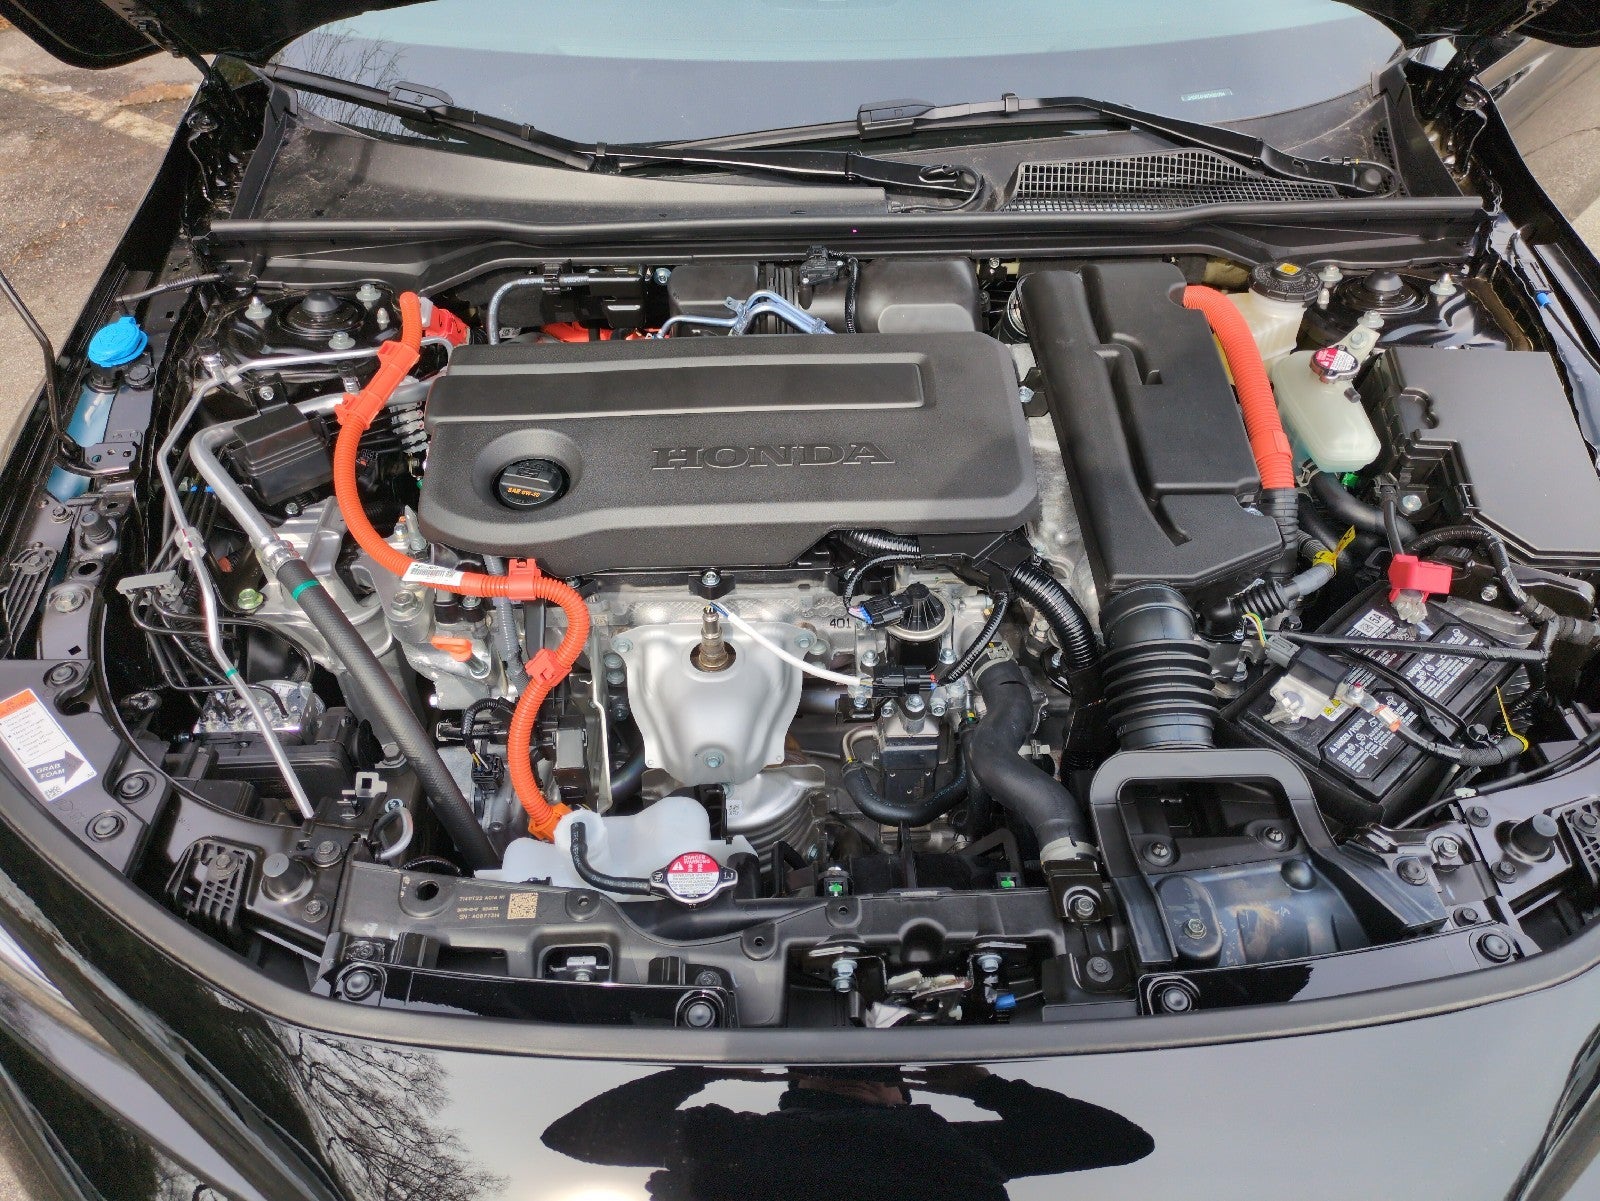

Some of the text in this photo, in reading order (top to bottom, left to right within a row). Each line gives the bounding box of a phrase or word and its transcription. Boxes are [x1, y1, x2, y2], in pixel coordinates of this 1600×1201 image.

[651, 443, 896, 470] HONDA
[829, 617, 852, 629] 401
[36, 763, 61, 774] GRAB
[40, 768, 65, 780] FOAM
